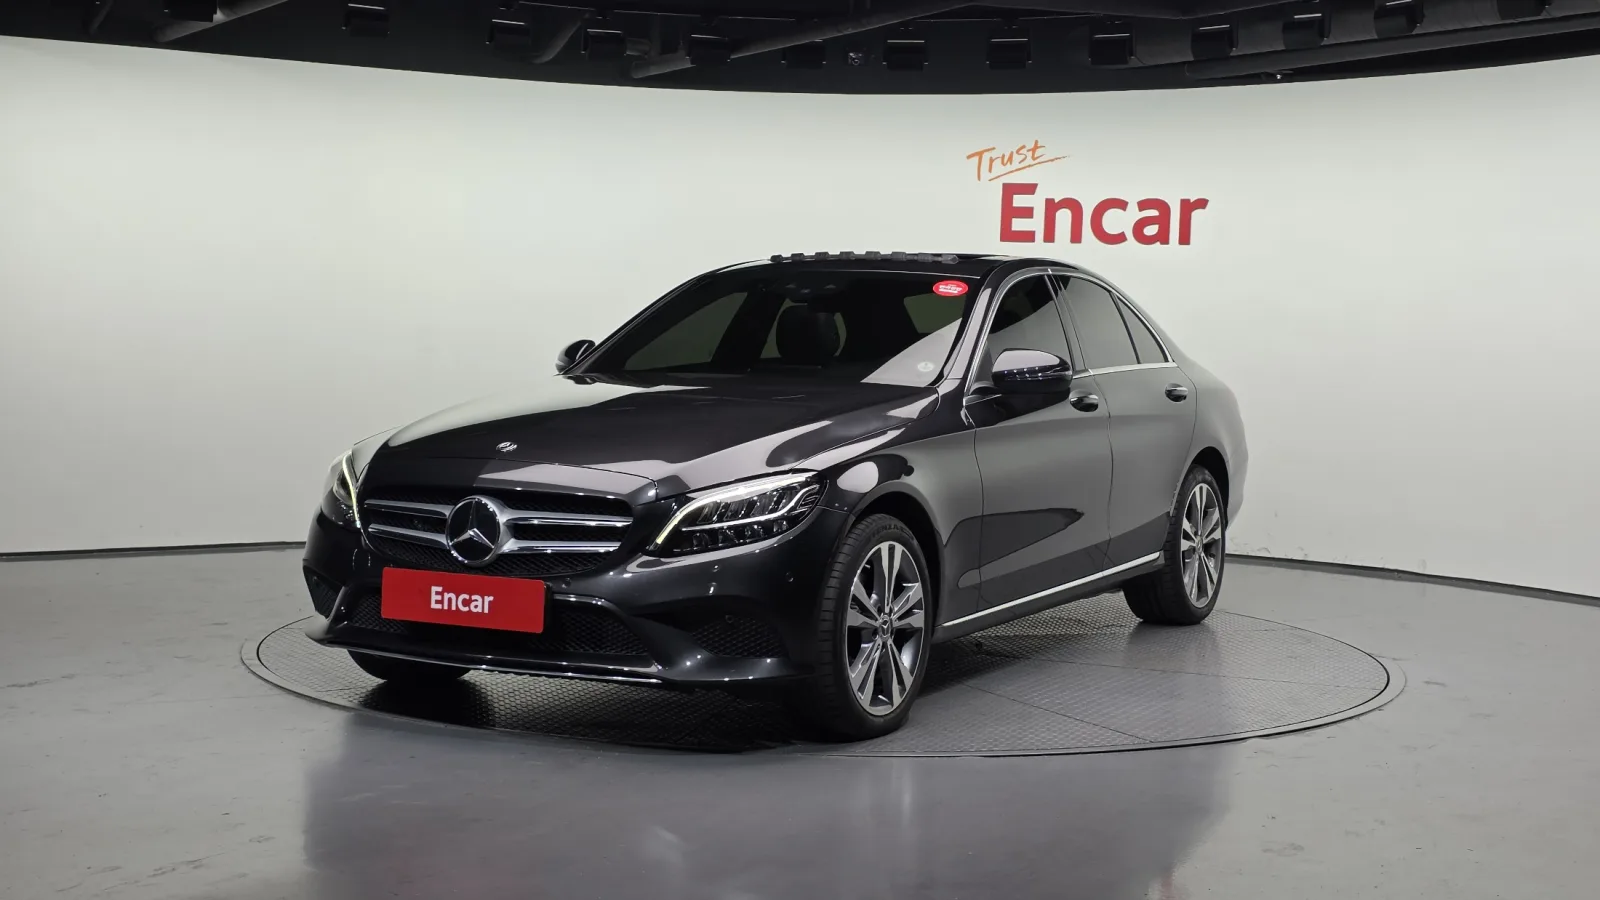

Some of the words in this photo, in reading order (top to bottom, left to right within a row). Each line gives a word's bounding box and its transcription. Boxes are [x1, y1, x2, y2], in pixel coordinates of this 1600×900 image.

[966, 139, 1047, 182] Trust
[1000, 182, 1210, 246] Encar
[430, 585, 494, 614] Encar
